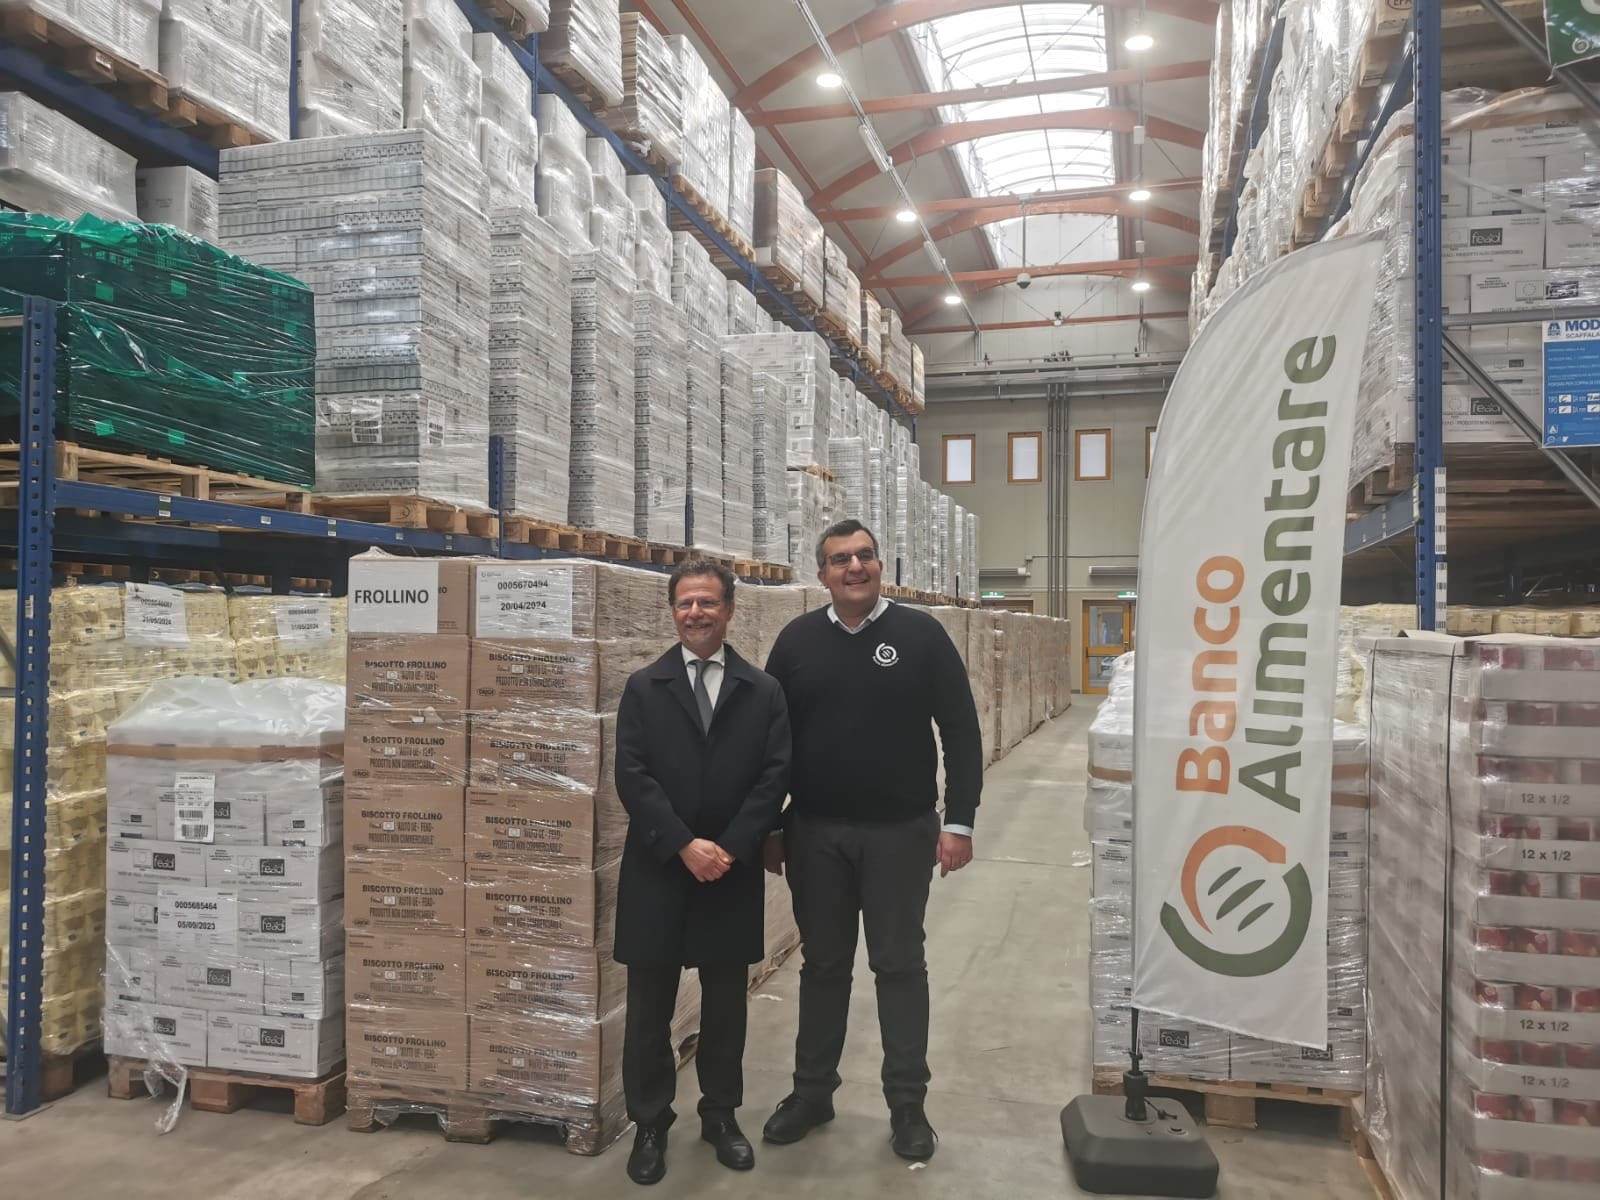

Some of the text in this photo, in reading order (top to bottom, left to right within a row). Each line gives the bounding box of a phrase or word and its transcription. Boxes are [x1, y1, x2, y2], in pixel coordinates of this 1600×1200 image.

[1238, 334, 1337, 813] Alimentare
[498, 580, 549, 590] 0005670494
[354, 589, 429, 604] FROLLINO
[500, 601, 546, 611] 20/04/2024
[406, 661, 447, 669] FROLLINO
[1175, 554, 1245, 795] Banco
[363, 735, 445, 745] BISCOTTO FROLLINO
[1521, 793, 1570, 807] 12 x 1/2
[362, 810, 443, 820] BISCOTTO FROLLINO
[485, 816, 527, 825] BISCOTTO
[1522, 849, 1571, 861] 12 x 1/2
[362, 885, 444, 895] BISCOTTO FROLLINO
[485, 893, 572, 905] BISCOTTO FROLLINO
[362, 959, 402, 968] BISCOTTO
[486, 968, 528, 978] BISCOTTO
[1520, 1019, 1569, 1032] 12 x 1/2
[364, 1034, 447, 1047] BISCOTTO FROLLINO
[1521, 1075, 1535, 1086] 12
[1551, 1077, 1570, 1088] 1/2
